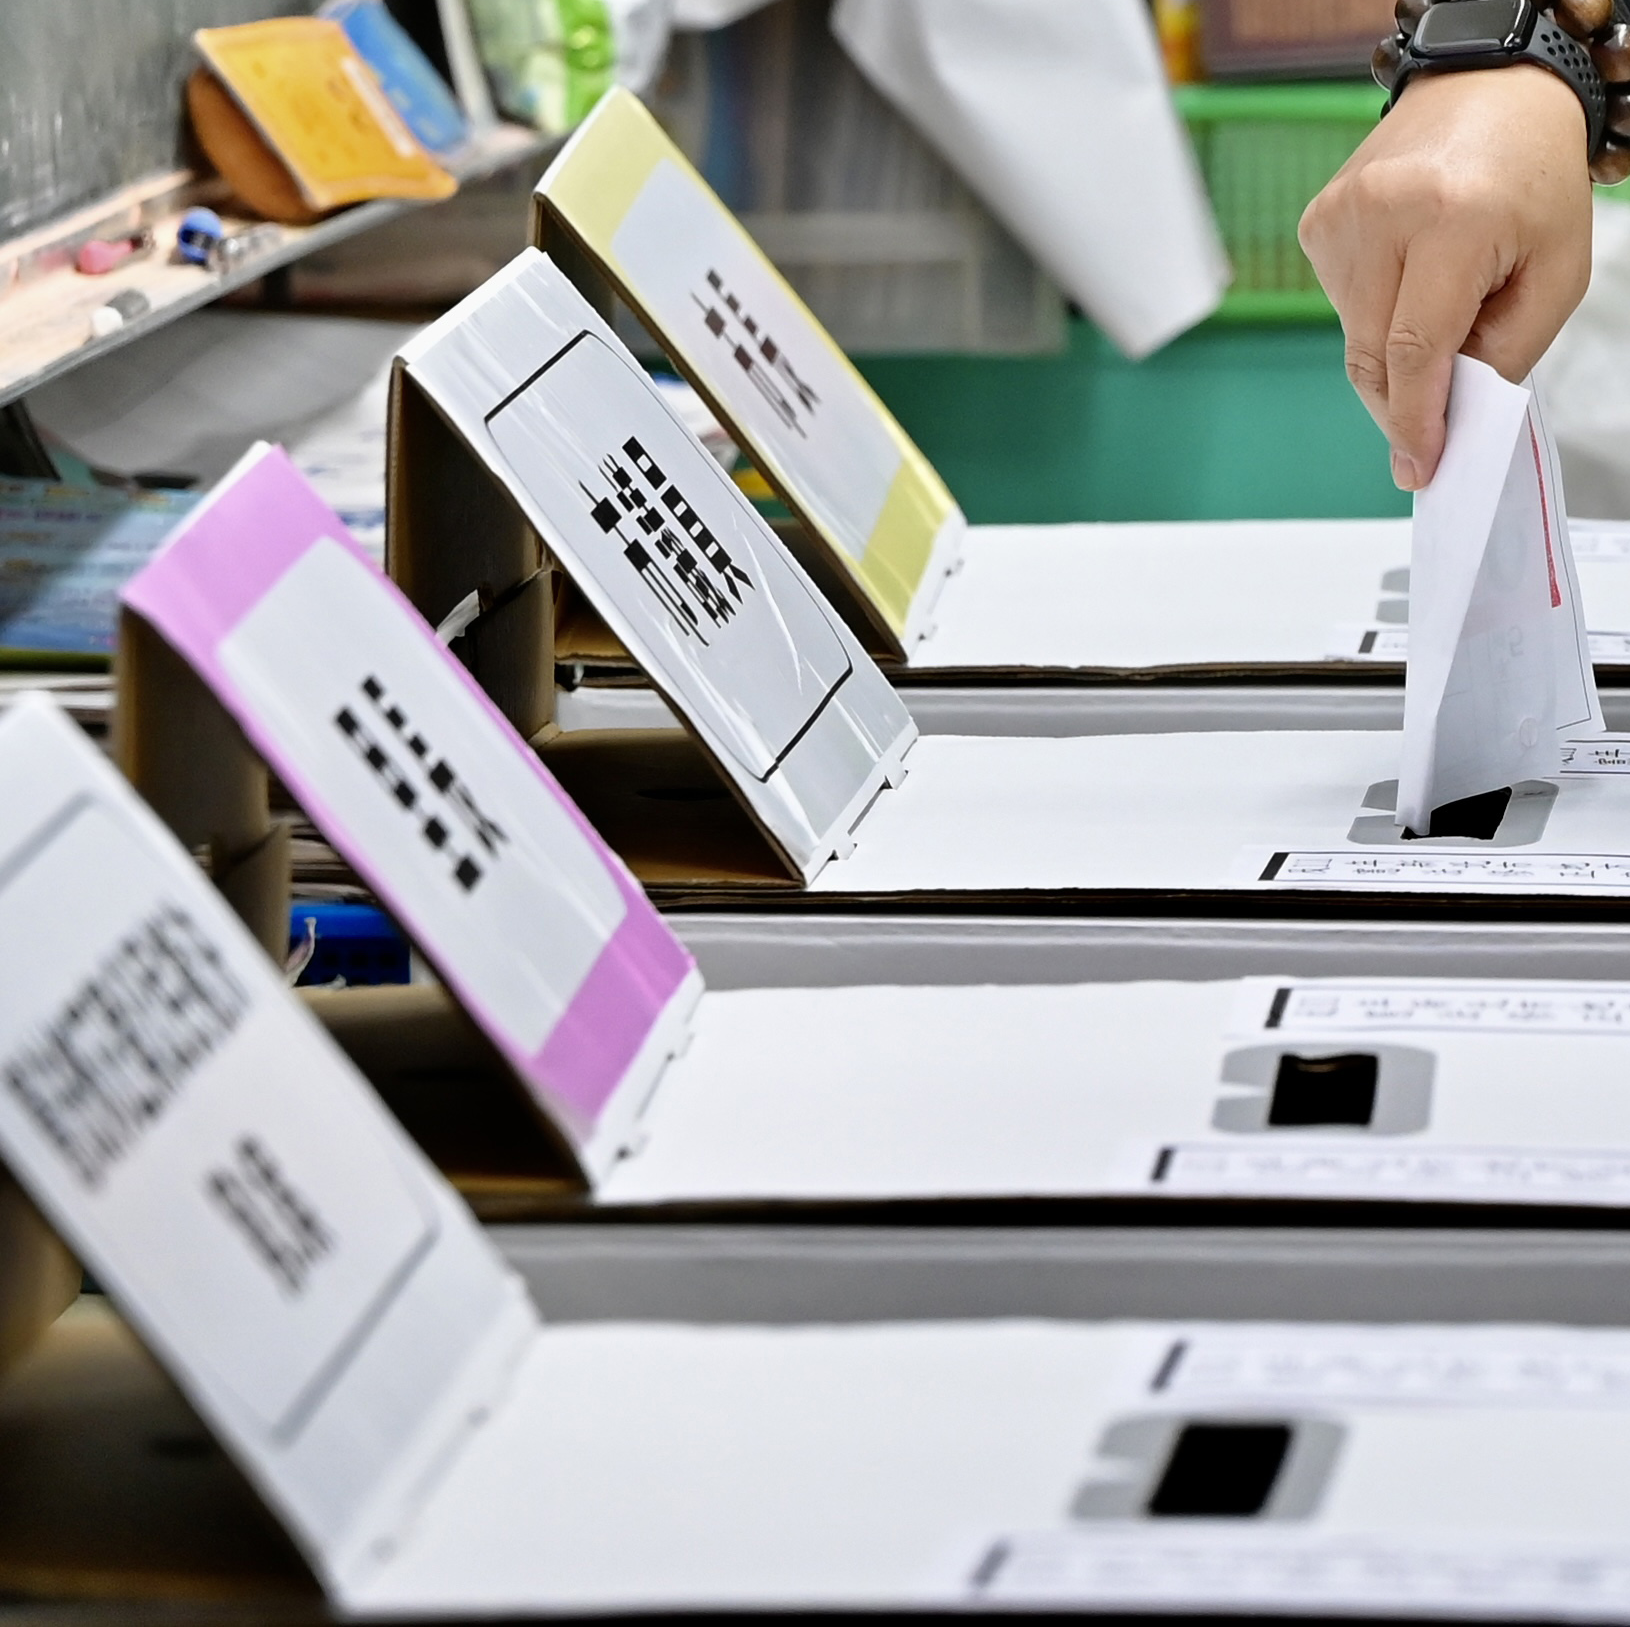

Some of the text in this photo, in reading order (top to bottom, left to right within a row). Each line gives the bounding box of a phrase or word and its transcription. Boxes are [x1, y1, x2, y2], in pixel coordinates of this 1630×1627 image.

[690, 269, 822, 439] 市長
[579, 436, 756, 648] 市議員
[335, 673, 511, 893] 里長
